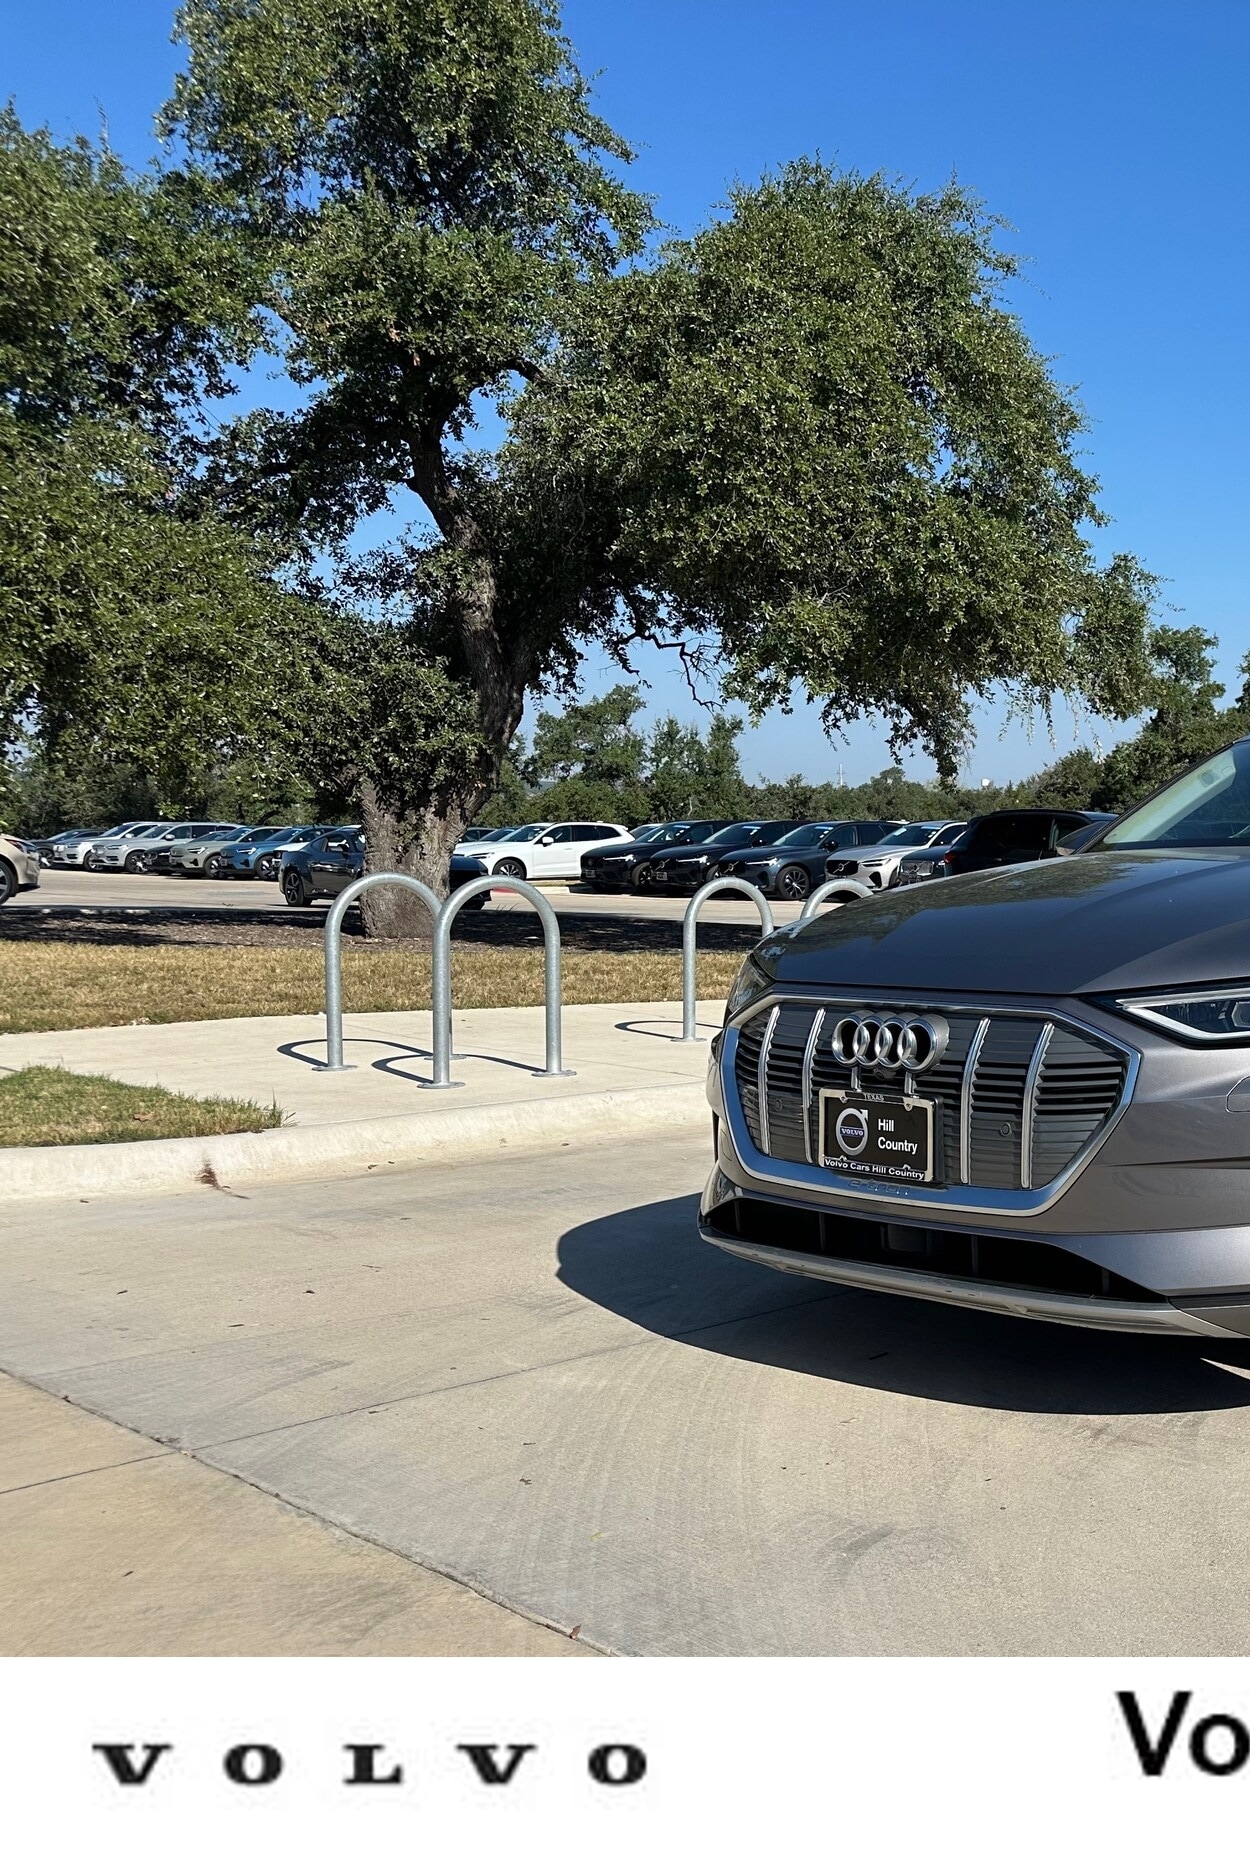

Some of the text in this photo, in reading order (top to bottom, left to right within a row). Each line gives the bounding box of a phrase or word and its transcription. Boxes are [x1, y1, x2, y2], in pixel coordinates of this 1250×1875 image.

[863, 1094, 885, 1102] TEXAS
[841, 1128, 864, 1136] VOLVO
[877, 1118, 894, 1132] Hill
[877, 1137, 918, 1155] Country
[824, 1158, 924, 1181] Volvo Cars Hill Country
